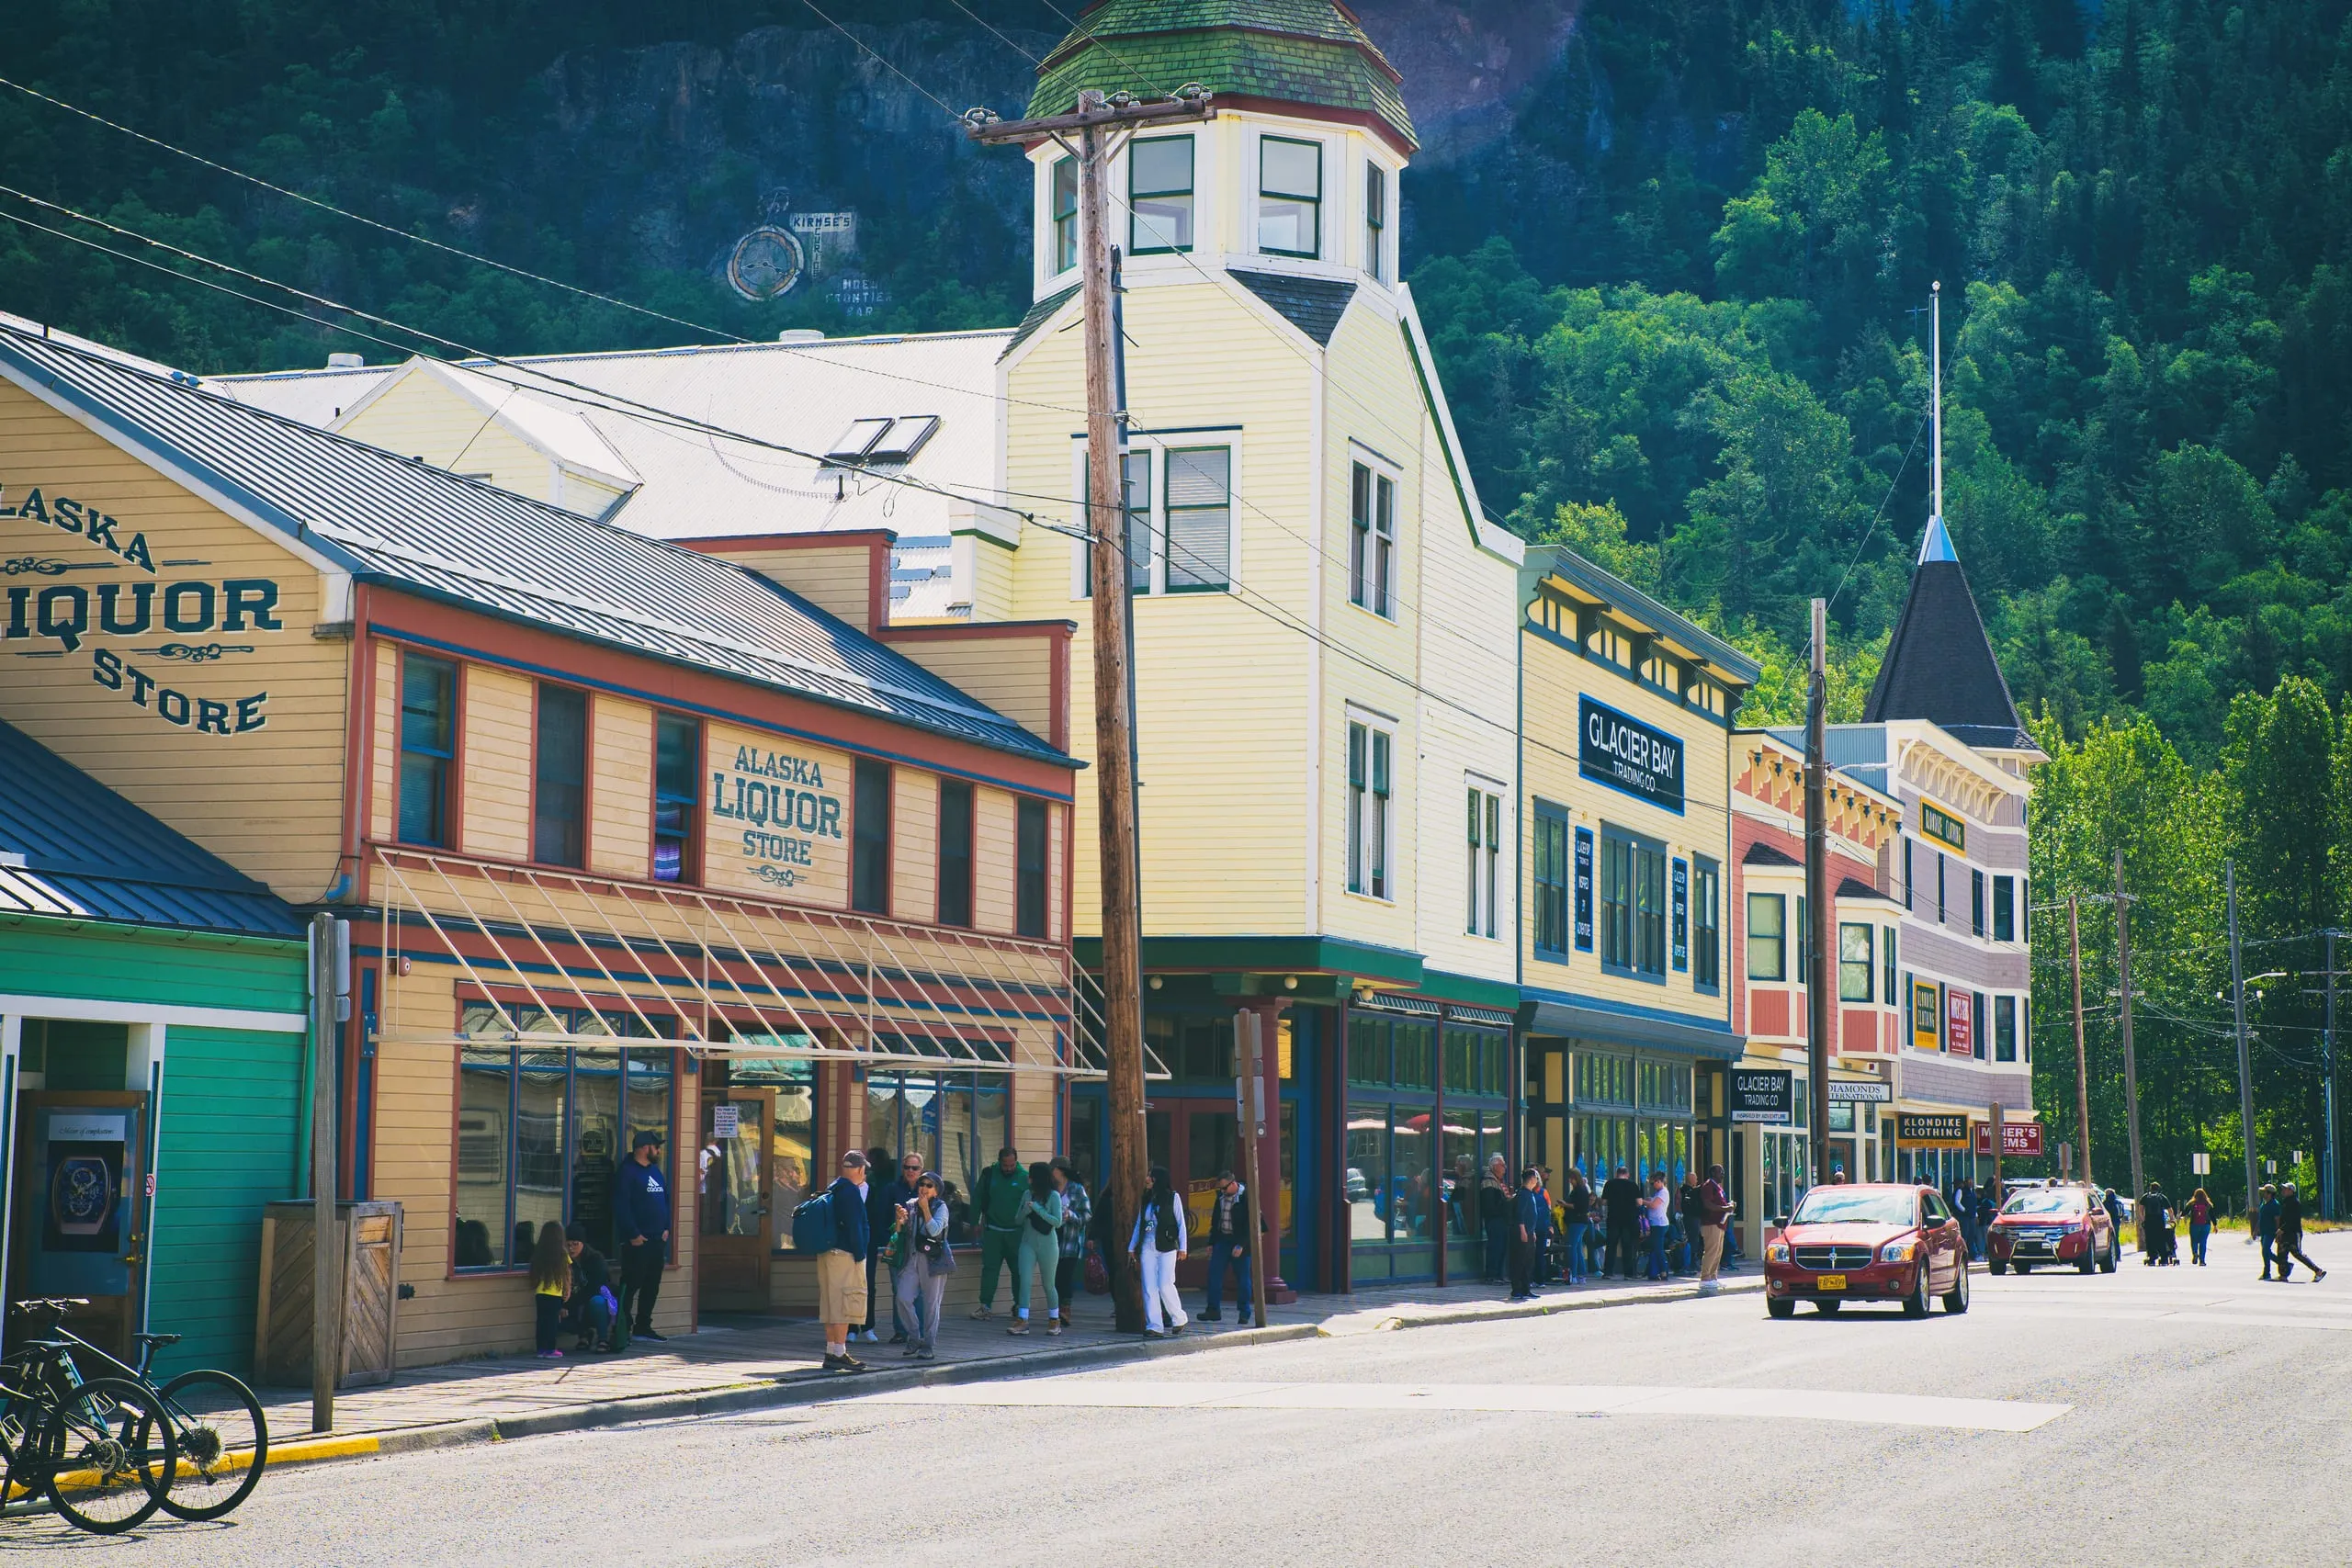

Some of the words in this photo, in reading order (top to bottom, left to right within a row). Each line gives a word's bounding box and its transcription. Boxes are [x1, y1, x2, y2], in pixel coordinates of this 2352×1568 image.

[793, 217, 852, 228] KIRMSE'S
[6, 578, 285, 654] IQUOR
[93, 648, 268, 737] STORE
[1589, 712, 1649, 769] GLACIER
[1652, 739, 1676, 779] BAY
[734, 745, 824, 789] ALASKA
[1612, 761, 1645, 788] TRADING
[1645, 774, 1656, 793] CO
[713, 772, 842, 840] LIQUOR
[742, 829, 812, 866] STORE
[1737, 1076, 1770, 1091] GLACIER
[1770, 1076, 1785, 1091] BAY
[1744, 1094, 1770, 1106] TRADING
[1770, 1094, 1779, 1106] CO
[1829, 1092, 1883, 1100] TERNATIONAL
[1904, 1117, 1962, 1127] KLONDIKE
[1904, 1128, 1962, 1137] CLOTHING
[1981, 1127, 2038, 1138] MER'S
